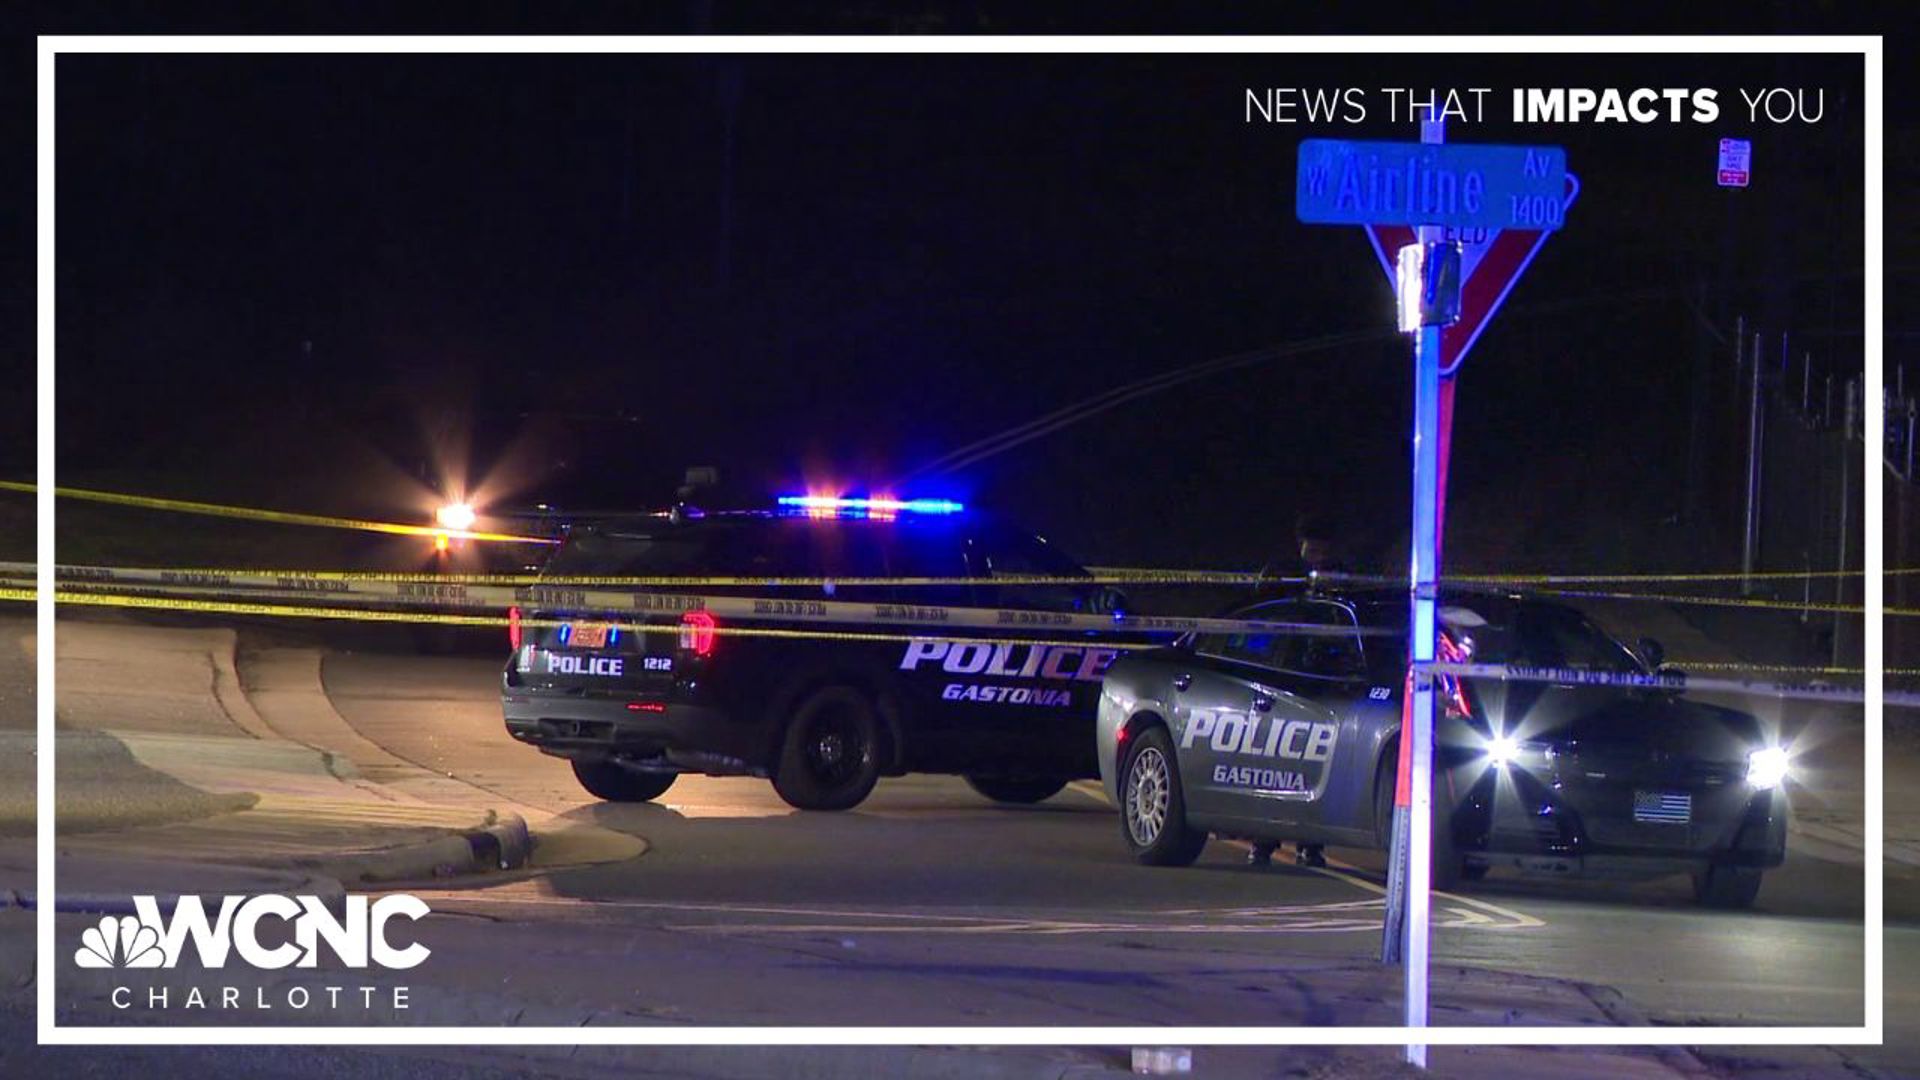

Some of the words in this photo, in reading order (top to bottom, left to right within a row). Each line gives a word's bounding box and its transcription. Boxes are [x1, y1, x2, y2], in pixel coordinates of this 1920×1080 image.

[1335, 152, 1485, 215] Airline
[1523, 149, 1550, 179] Av
[1511, 196, 1560, 226] 1400
[549, 655, 622, 676] POLICE
[643, 657, 672, 671] 1212
[901, 640, 1118, 681] POLICE
[942, 684, 1072, 706] GASTONIA
[1181, 710, 1339, 762] POLICE
[1213, 765, 1306, 789] GASTONIA
